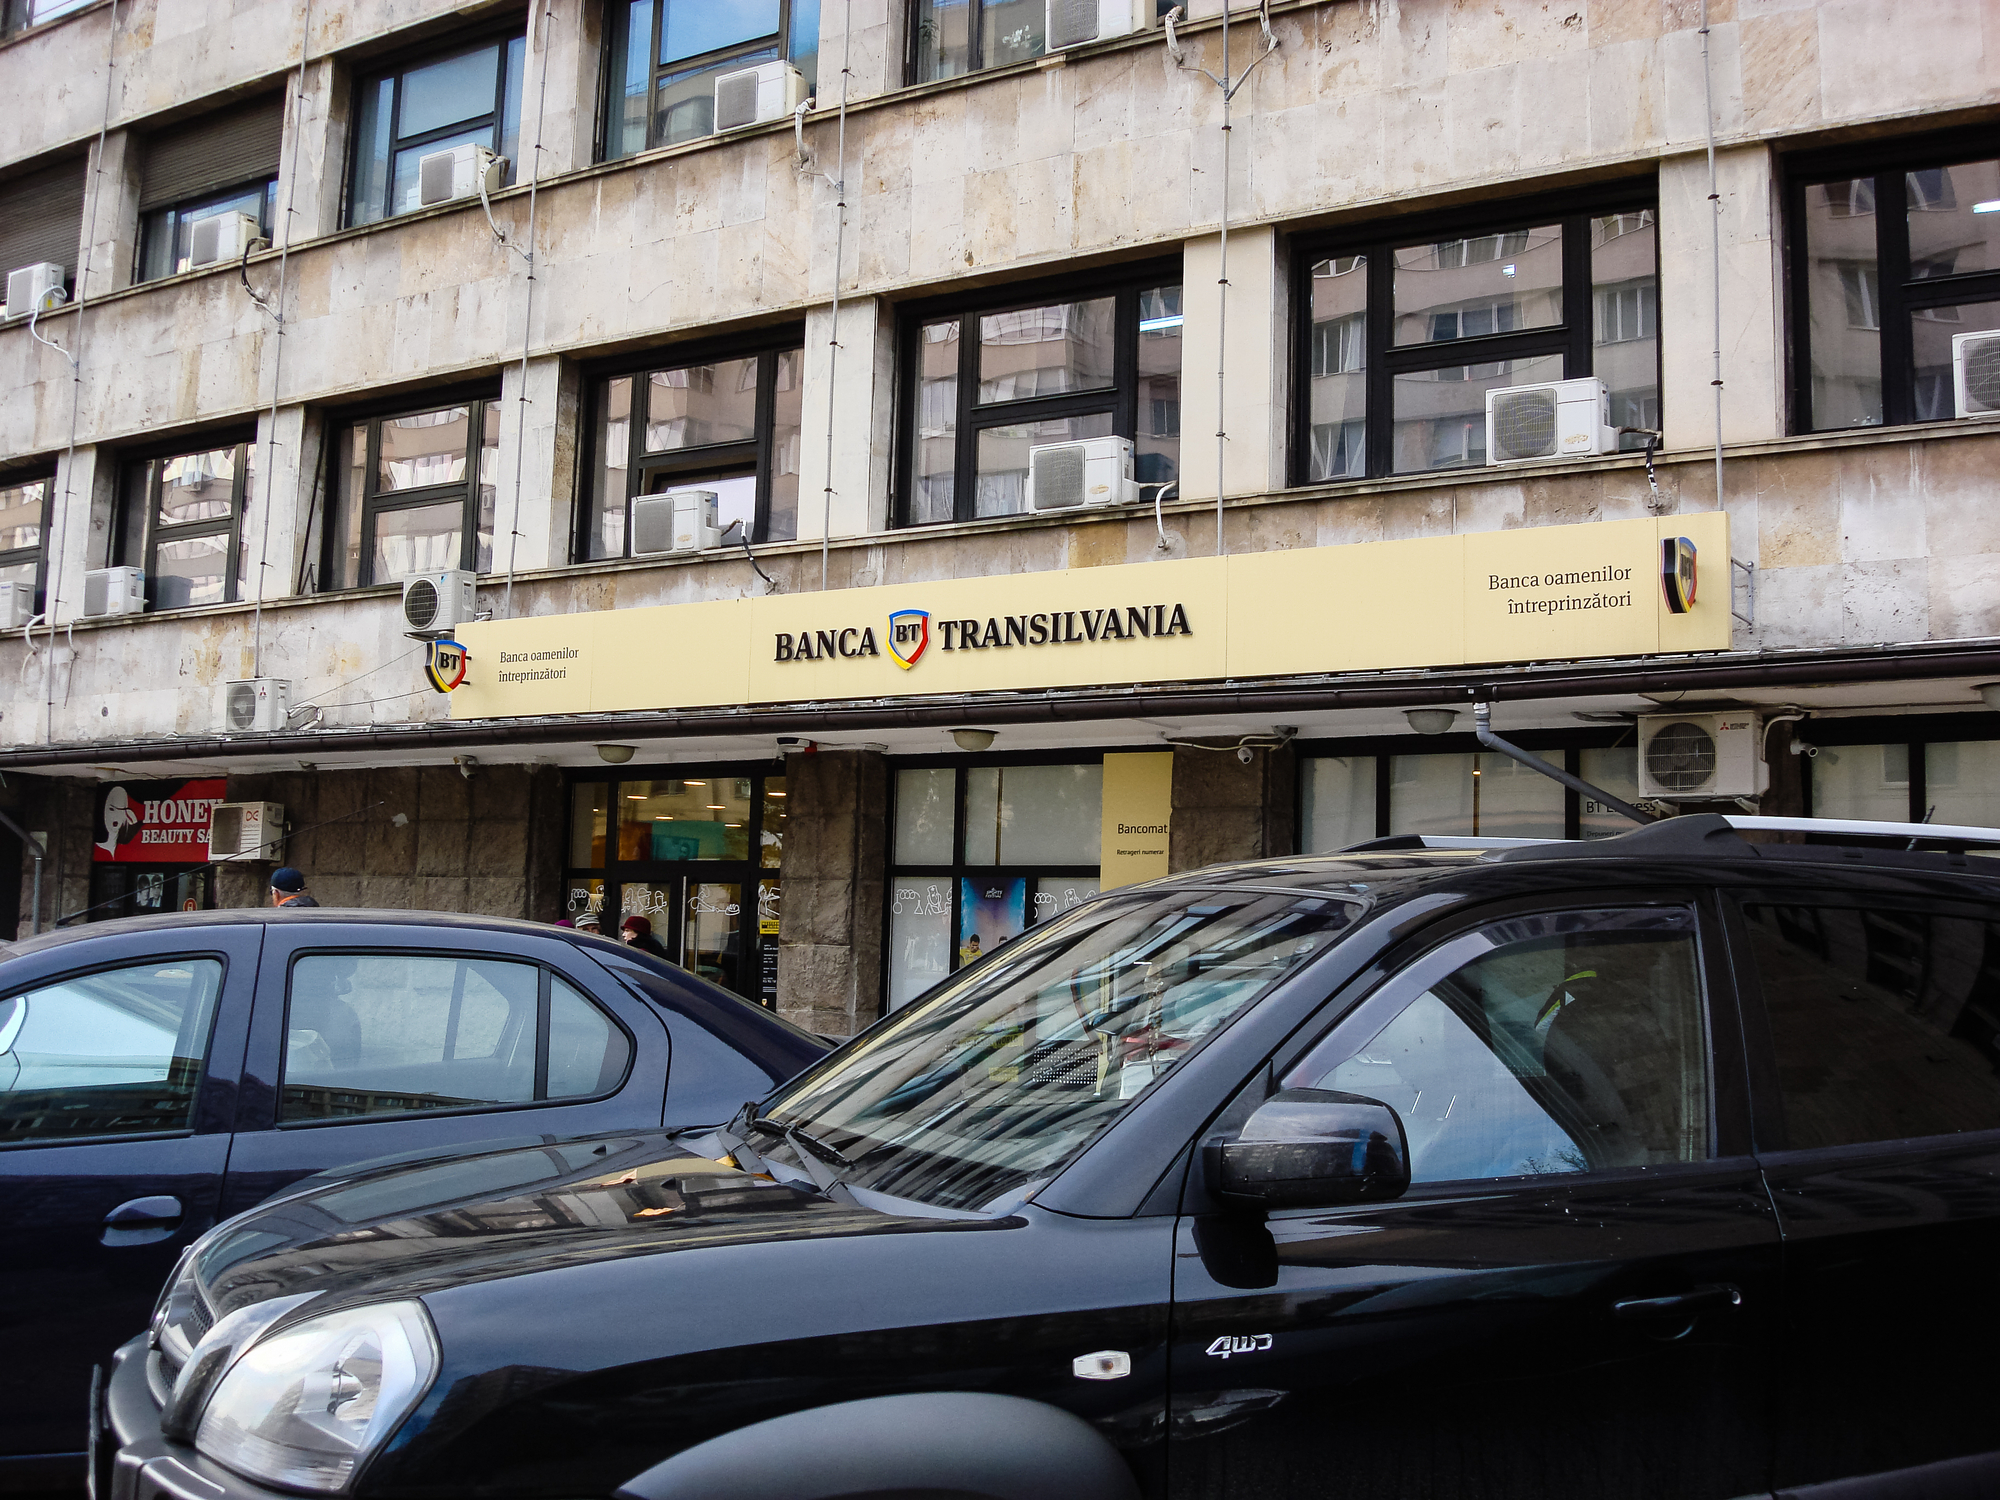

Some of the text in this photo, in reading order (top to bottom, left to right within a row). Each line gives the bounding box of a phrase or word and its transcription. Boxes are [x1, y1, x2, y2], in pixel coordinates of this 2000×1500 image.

[1488, 566, 1632, 591] Banca oamenilor
[1507, 591, 1632, 615] întreprinzători
[774, 603, 1193, 663] BANCA BT TRANSILVANIA
[439, 651, 461, 670] BT
[500, 646, 580, 664] Banca oamenilor
[498, 666, 567, 684] întreprinzători
[141, 828, 212, 844] BEAUTY SA
[1117, 823, 1168, 834] Bancomat
[1116, 849, 1141, 857] Retrageri
[1205, 1333, 1273, 1359] 4WD
